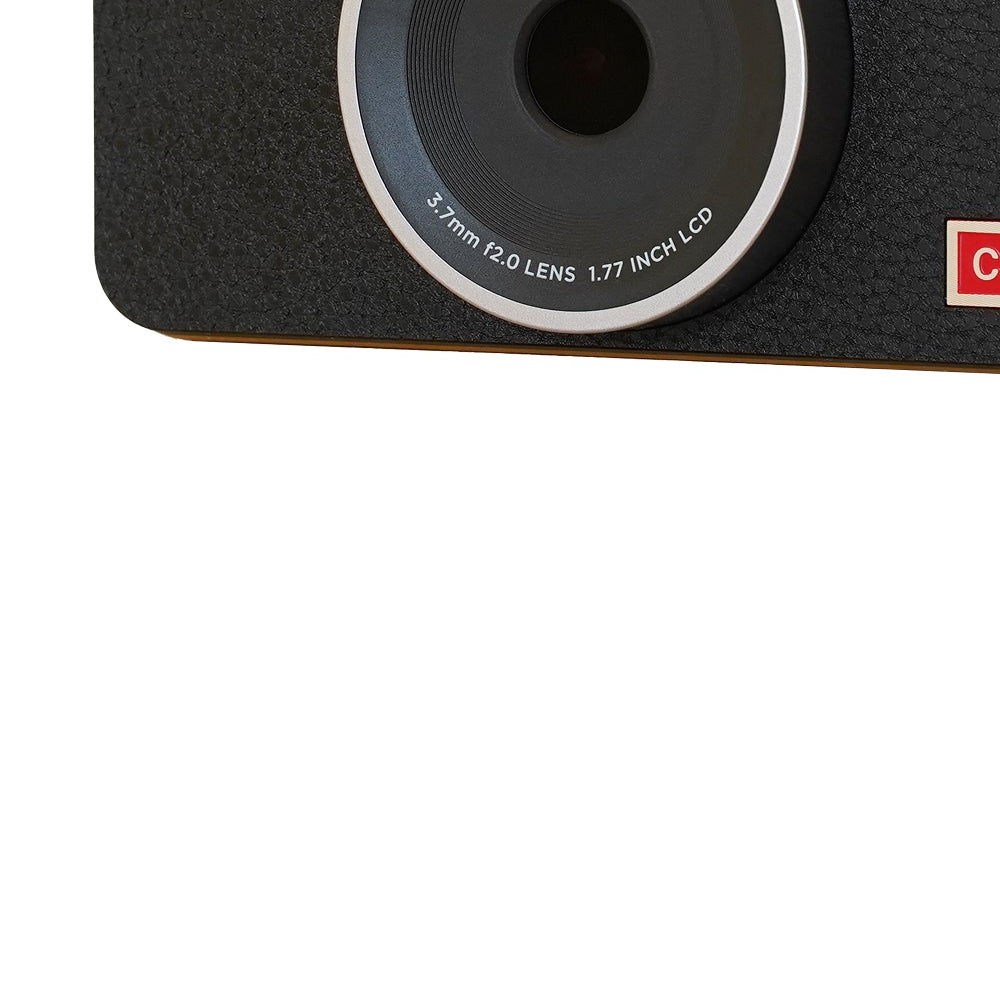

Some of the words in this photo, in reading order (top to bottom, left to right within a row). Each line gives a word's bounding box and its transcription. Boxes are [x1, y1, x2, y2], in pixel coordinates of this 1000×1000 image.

[426, 191, 481, 249] 3.7mm
[482, 241, 521, 271] f2.0
[523, 258, 576, 283] LENS
[588, 260, 624, 282] 1.77
[630, 237, 677, 273] INCH
[677, 207, 713, 245] LCD
